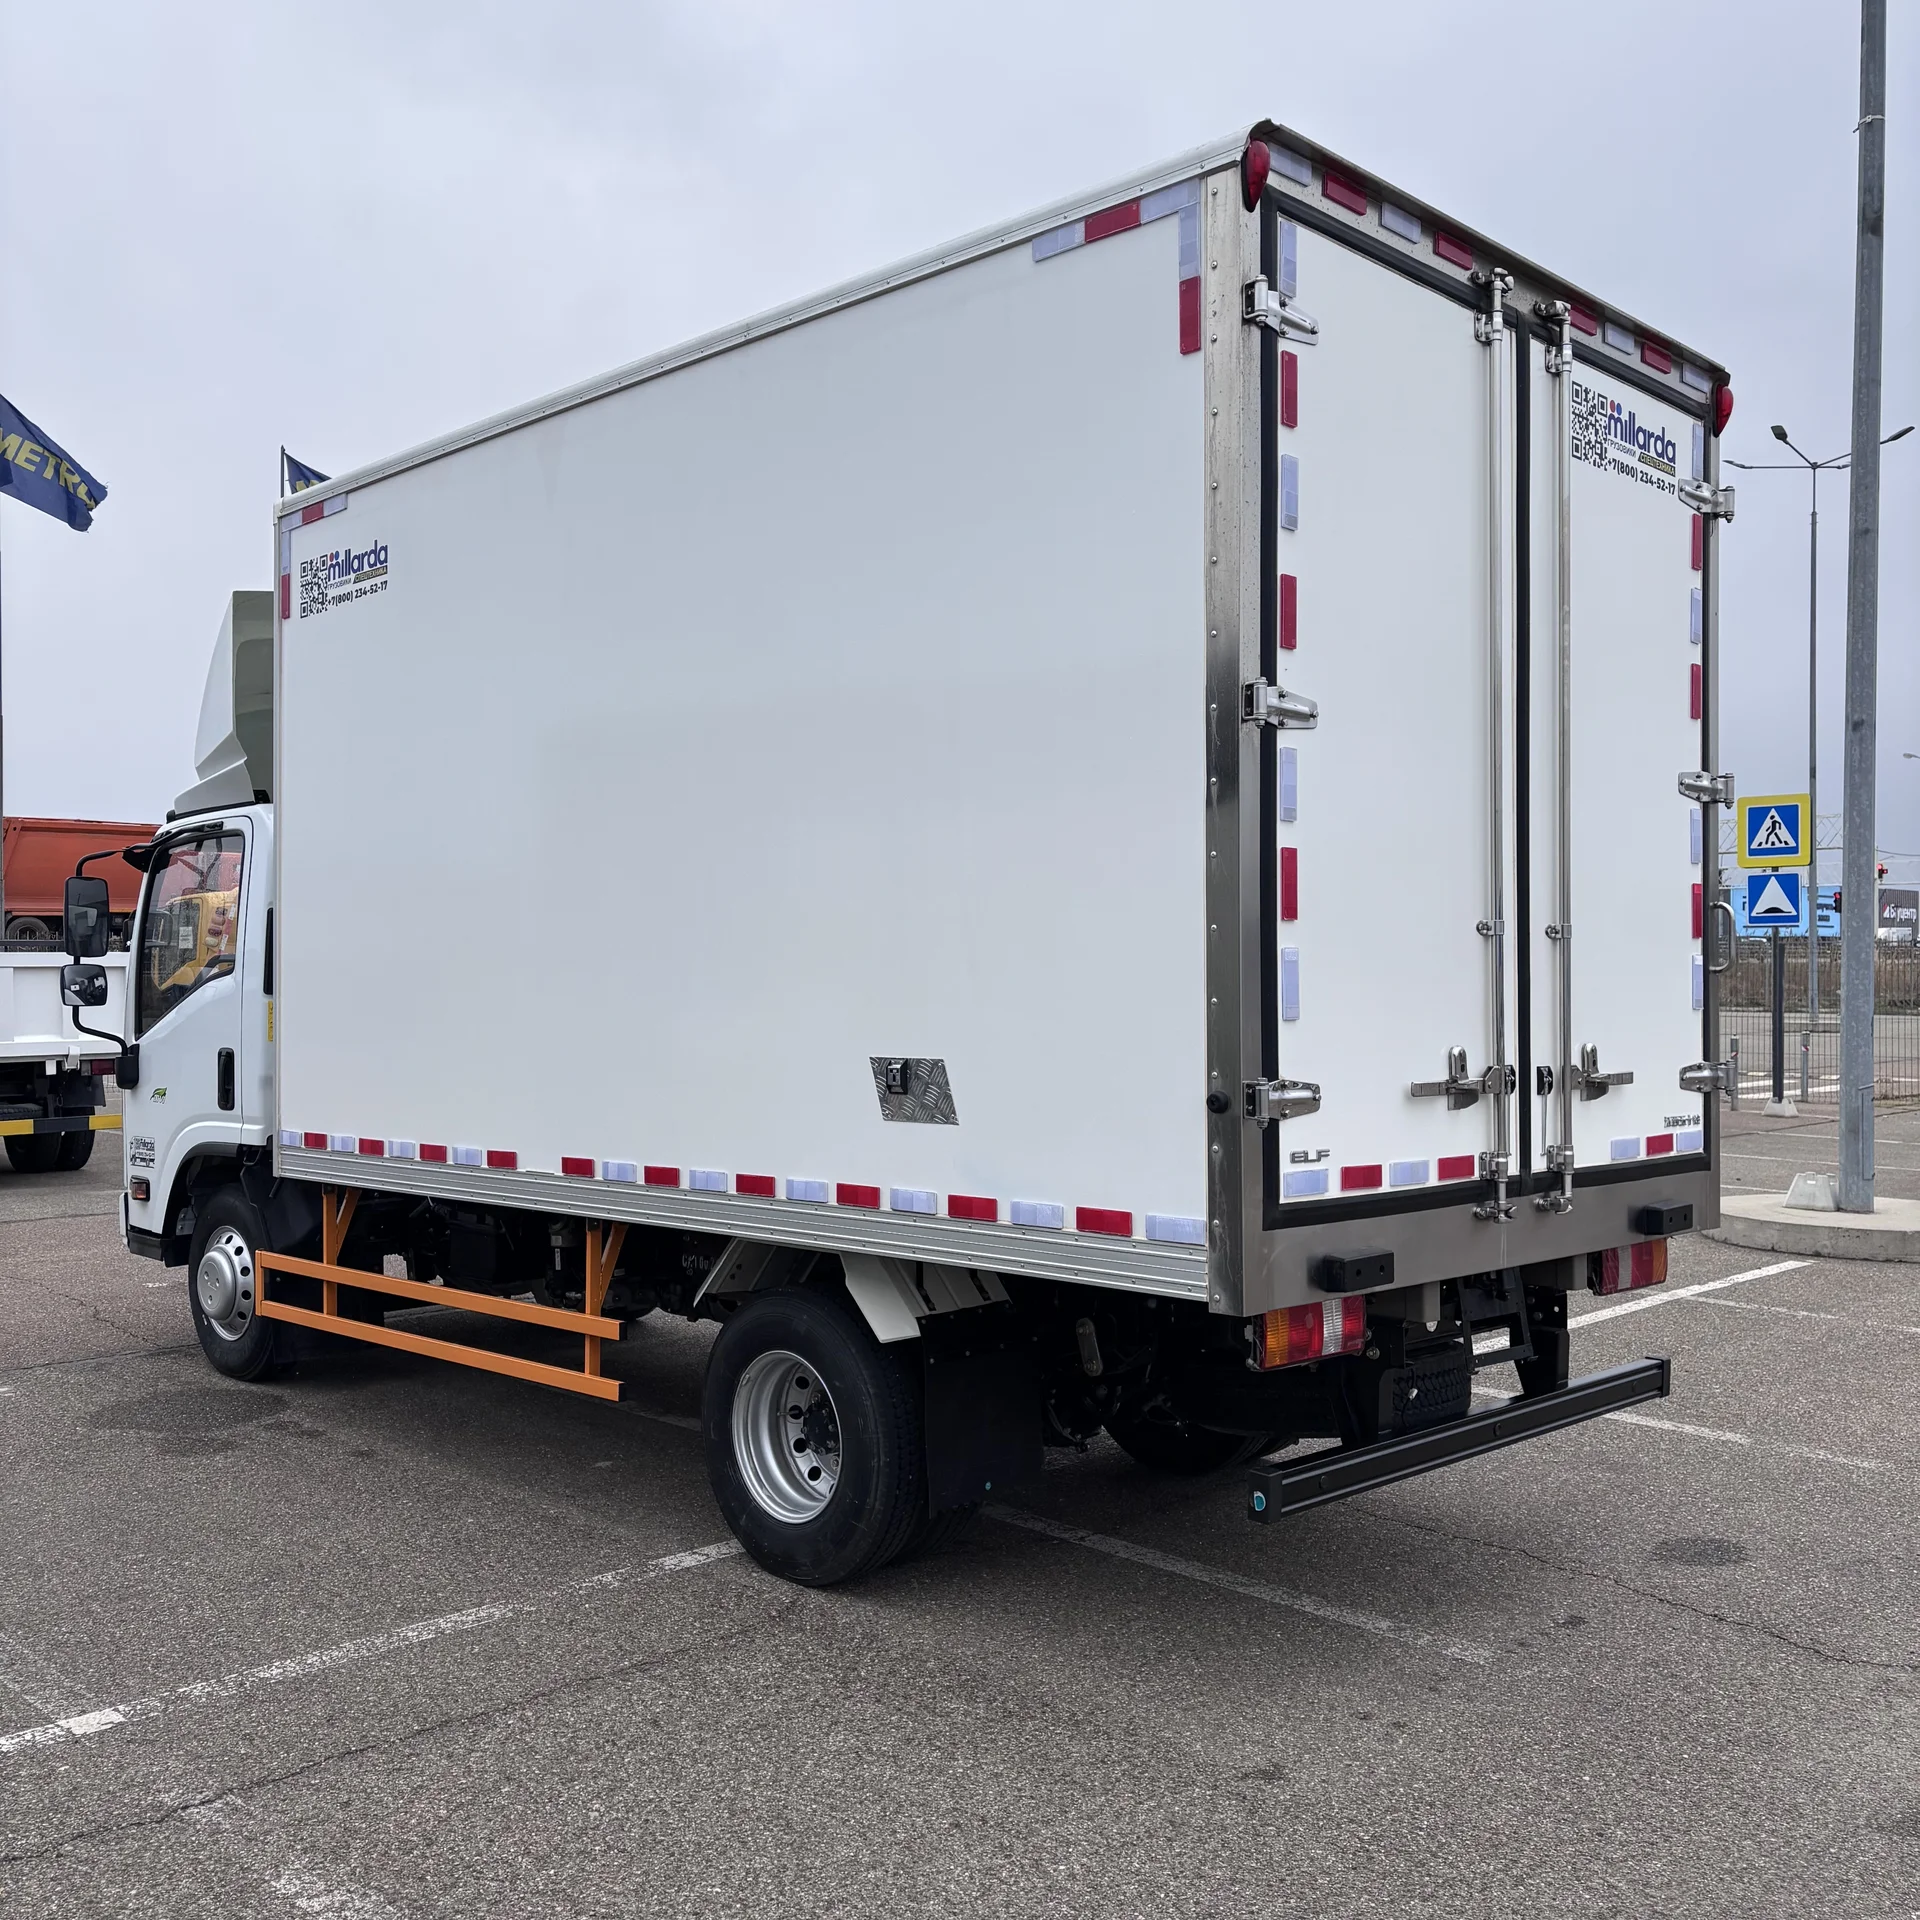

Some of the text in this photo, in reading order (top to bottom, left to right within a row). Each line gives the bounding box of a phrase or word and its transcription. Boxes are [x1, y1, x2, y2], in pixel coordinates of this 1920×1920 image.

[1607, 400, 1677, 465] millarda
[1607, 458, 1676, 495] +7(800) 234-52-17
[327, 539, 388, 582] millarda
[327, 580, 388, 606] +7(800) 234-52-17
[1289, 1149, 1331, 1164] ELF
